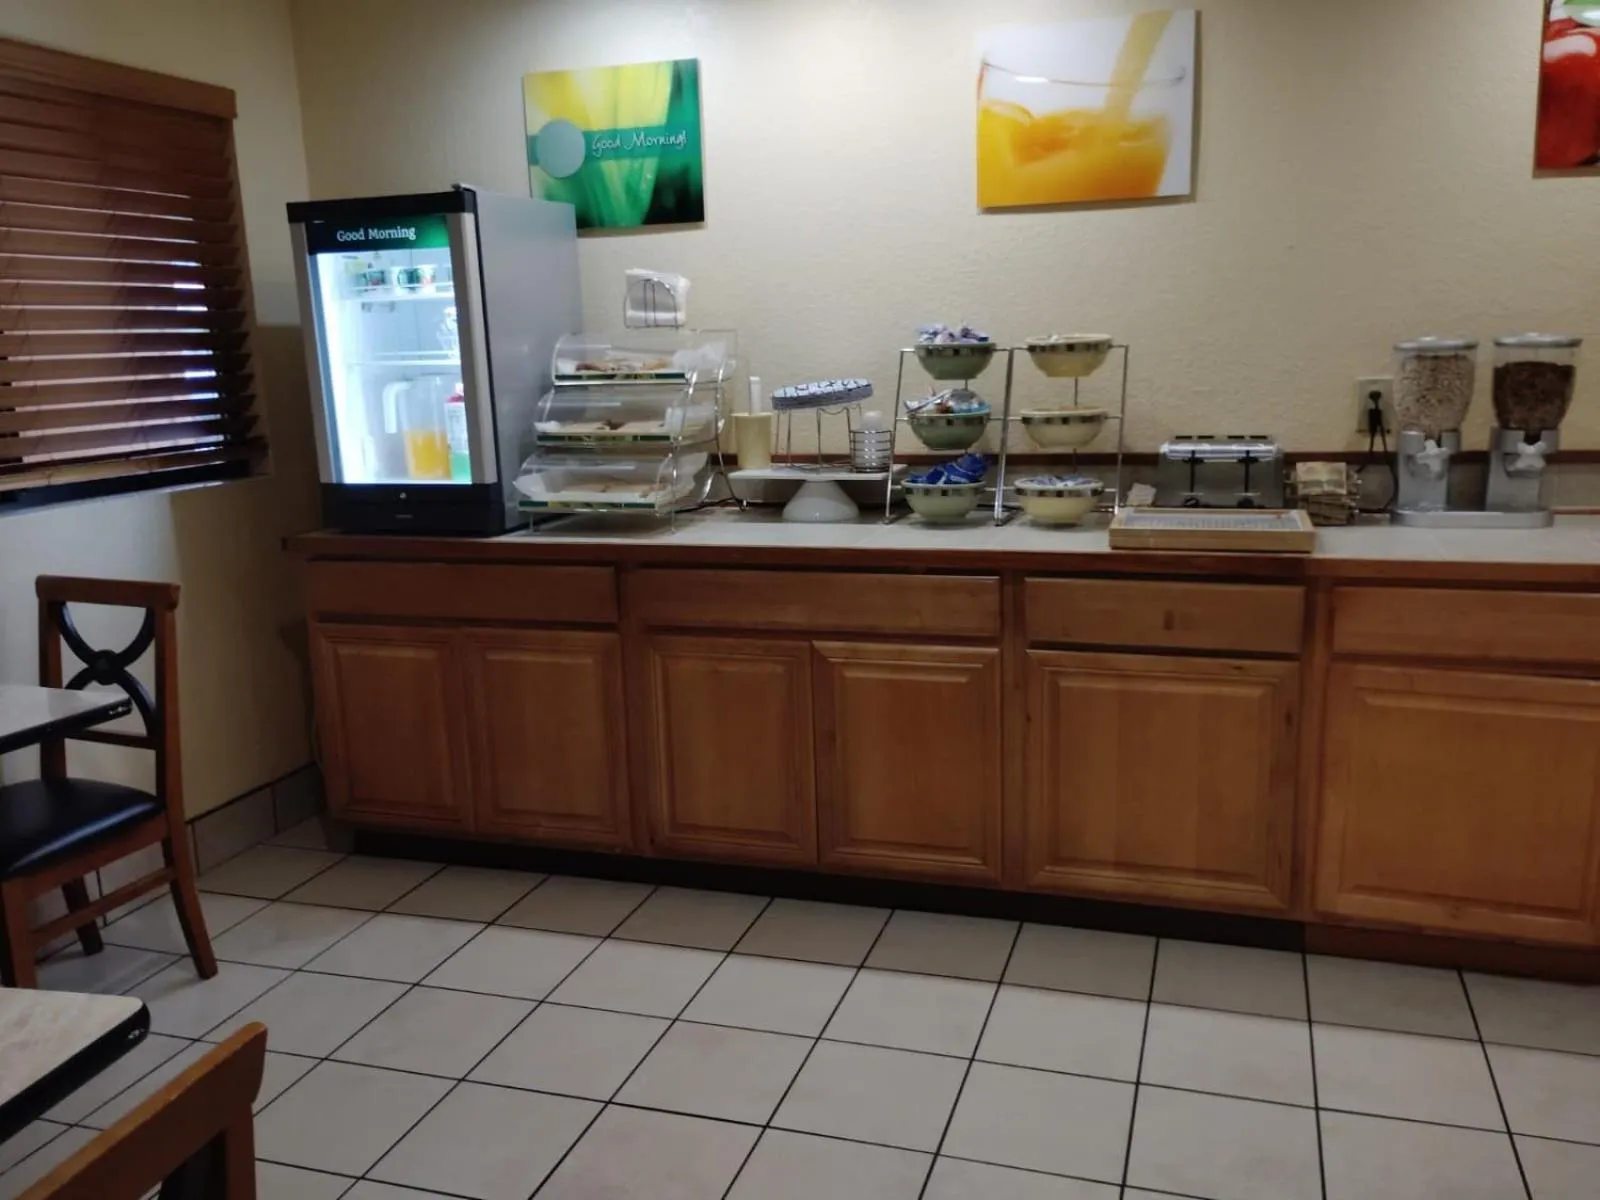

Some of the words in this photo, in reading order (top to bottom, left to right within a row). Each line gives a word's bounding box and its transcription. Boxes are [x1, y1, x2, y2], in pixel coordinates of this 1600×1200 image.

[592, 133, 621, 157] Good
[624, 130, 687, 150] Morning!
[336, 227, 365, 242] Good
[368, 226, 417, 241] Morning
